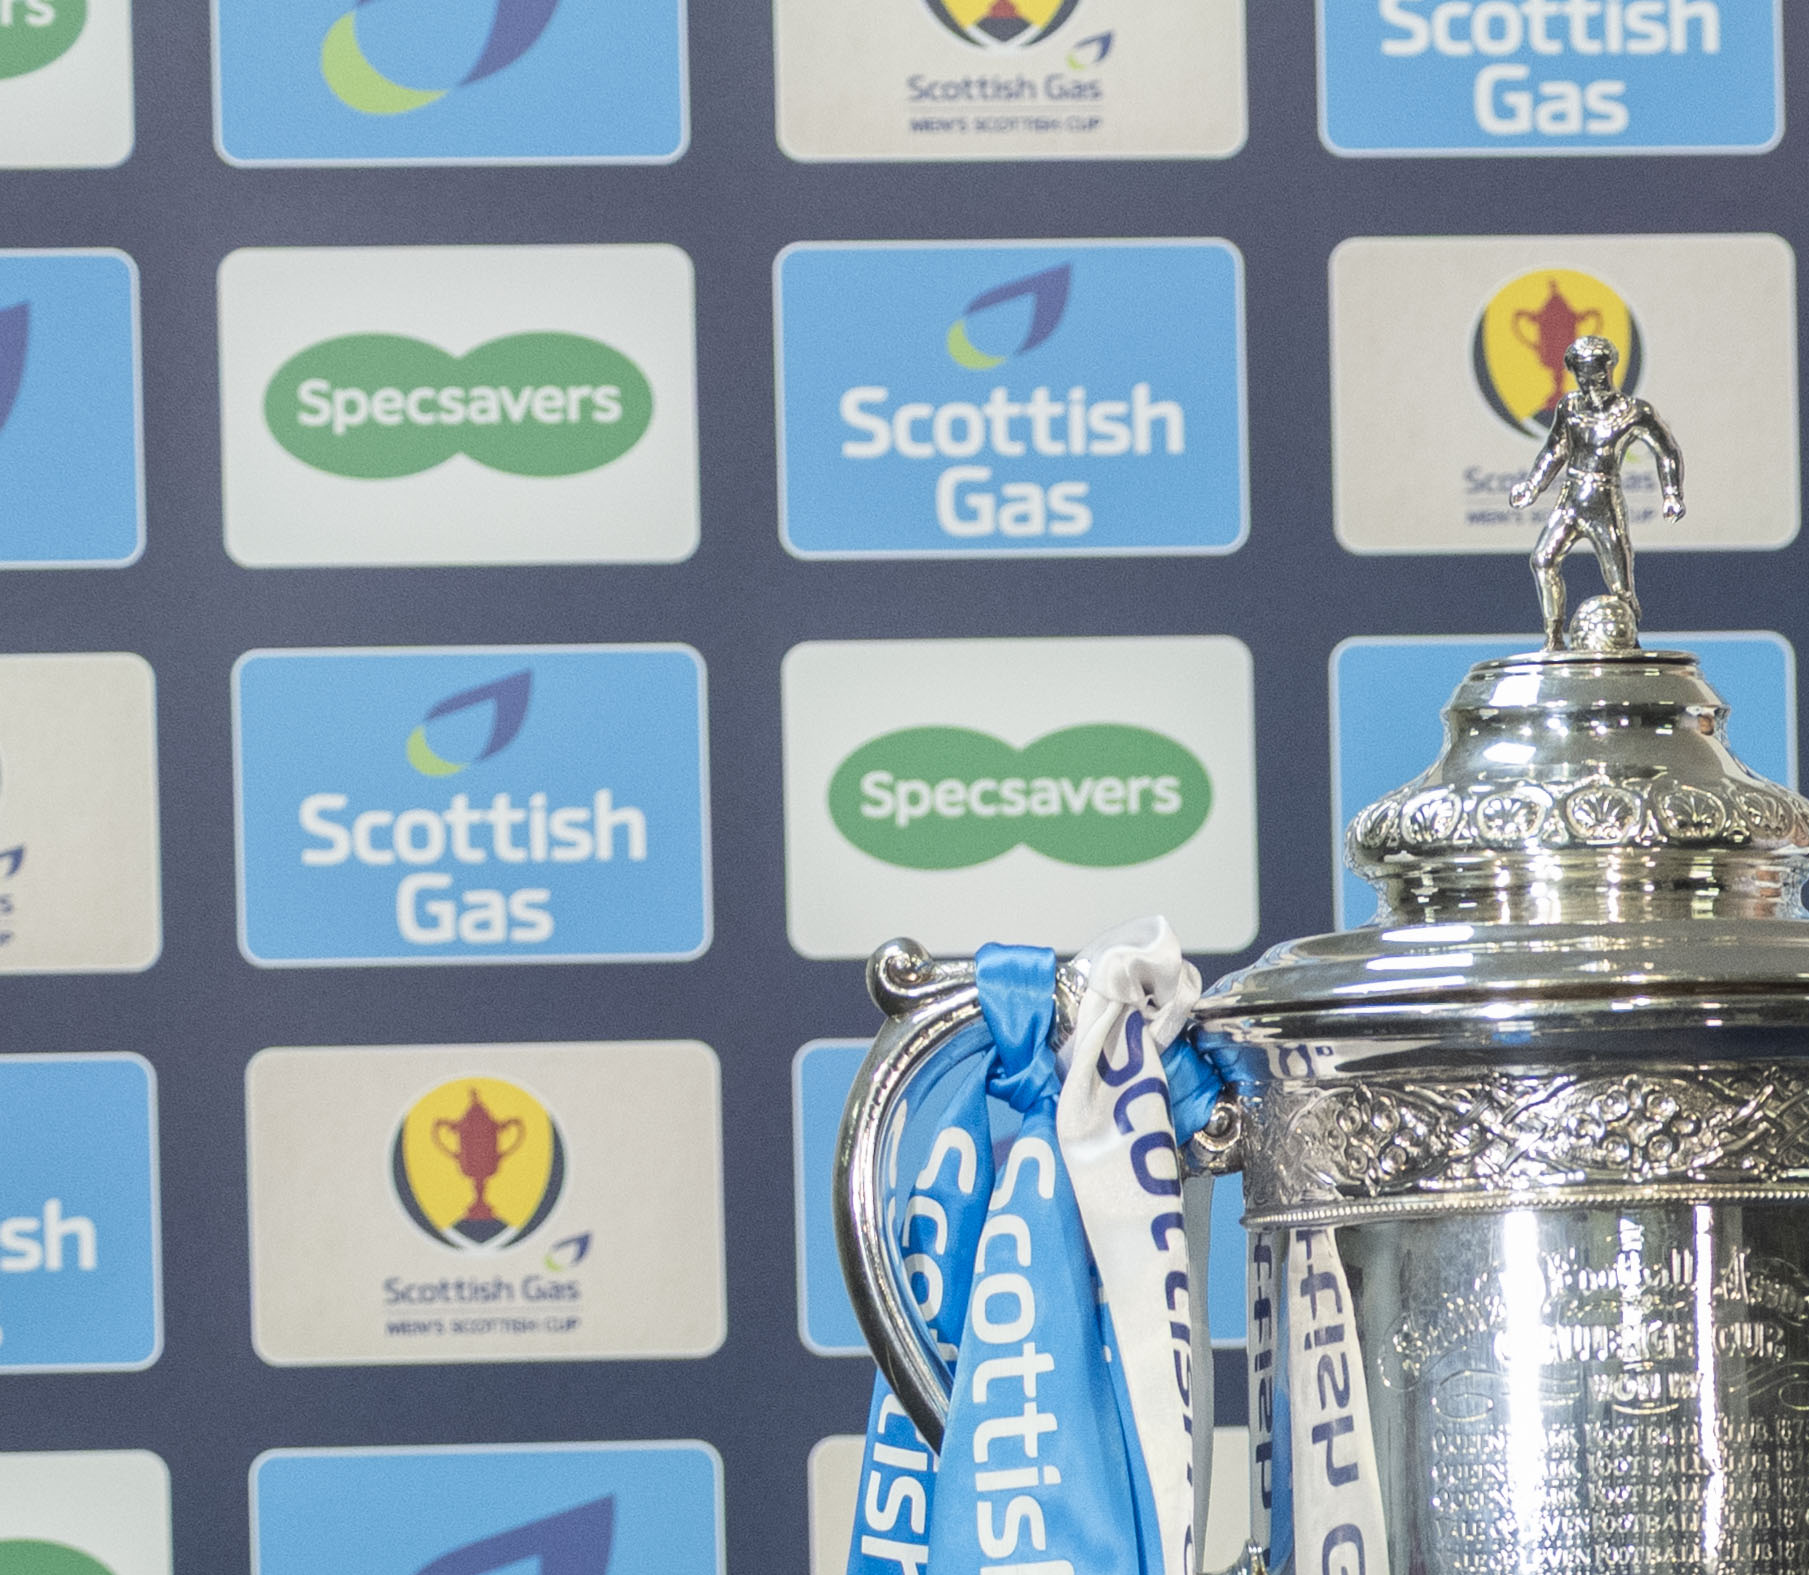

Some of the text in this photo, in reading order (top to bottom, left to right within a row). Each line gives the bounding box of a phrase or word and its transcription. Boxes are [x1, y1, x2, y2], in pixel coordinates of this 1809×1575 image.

[1379, 0, 1720, 56] Scottish
[906, 73, 1104, 103] Scottish Gas
[1474, 63, 1629, 136] Gas
[1068, 115, 1104, 133] CUP
[297, 378, 623, 436] Specsavers
[839, 382, 1185, 459] Scottish
[936, 465, 1093, 537] Gas
[299, 788, 647, 866] Scottish
[860, 770, 1182, 828] Specsavers
[396, 872, 554, 945] Gas
[382, 1275, 581, 1306] Scottish Gas
[544, 1316, 580, 1333] CUP
